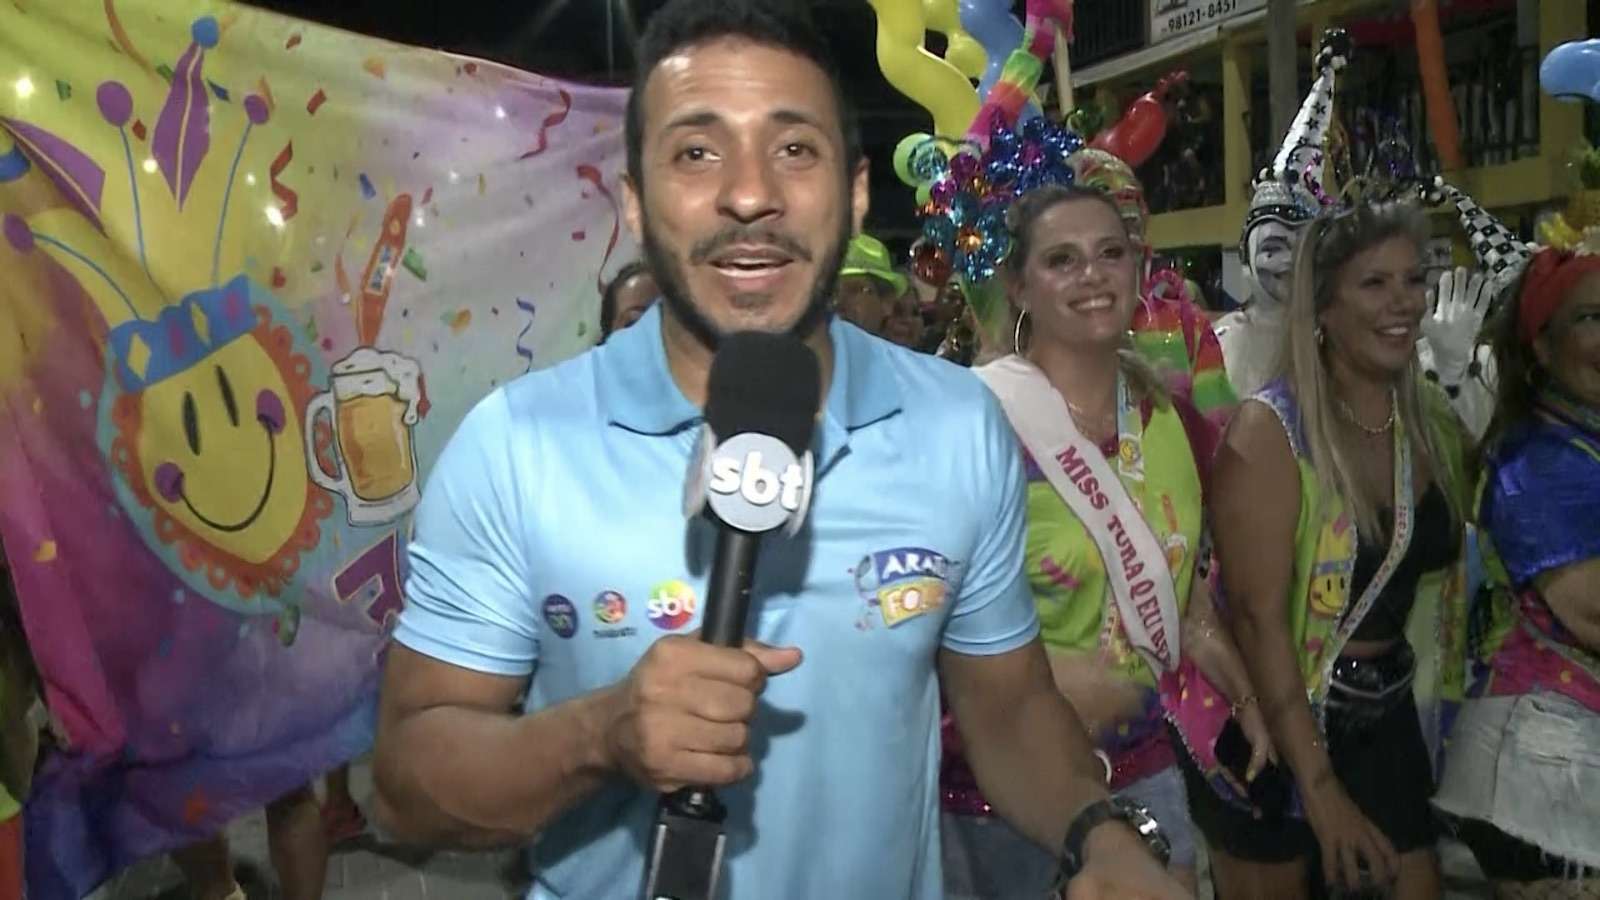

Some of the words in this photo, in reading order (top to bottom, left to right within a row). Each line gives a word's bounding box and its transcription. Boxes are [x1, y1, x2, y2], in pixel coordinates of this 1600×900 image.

[709, 450, 803, 513] sbt
[1055, 445, 1110, 510] MISS
[1106, 514, 1145, 582] TURA
[648, 589, 695, 618] sbt
